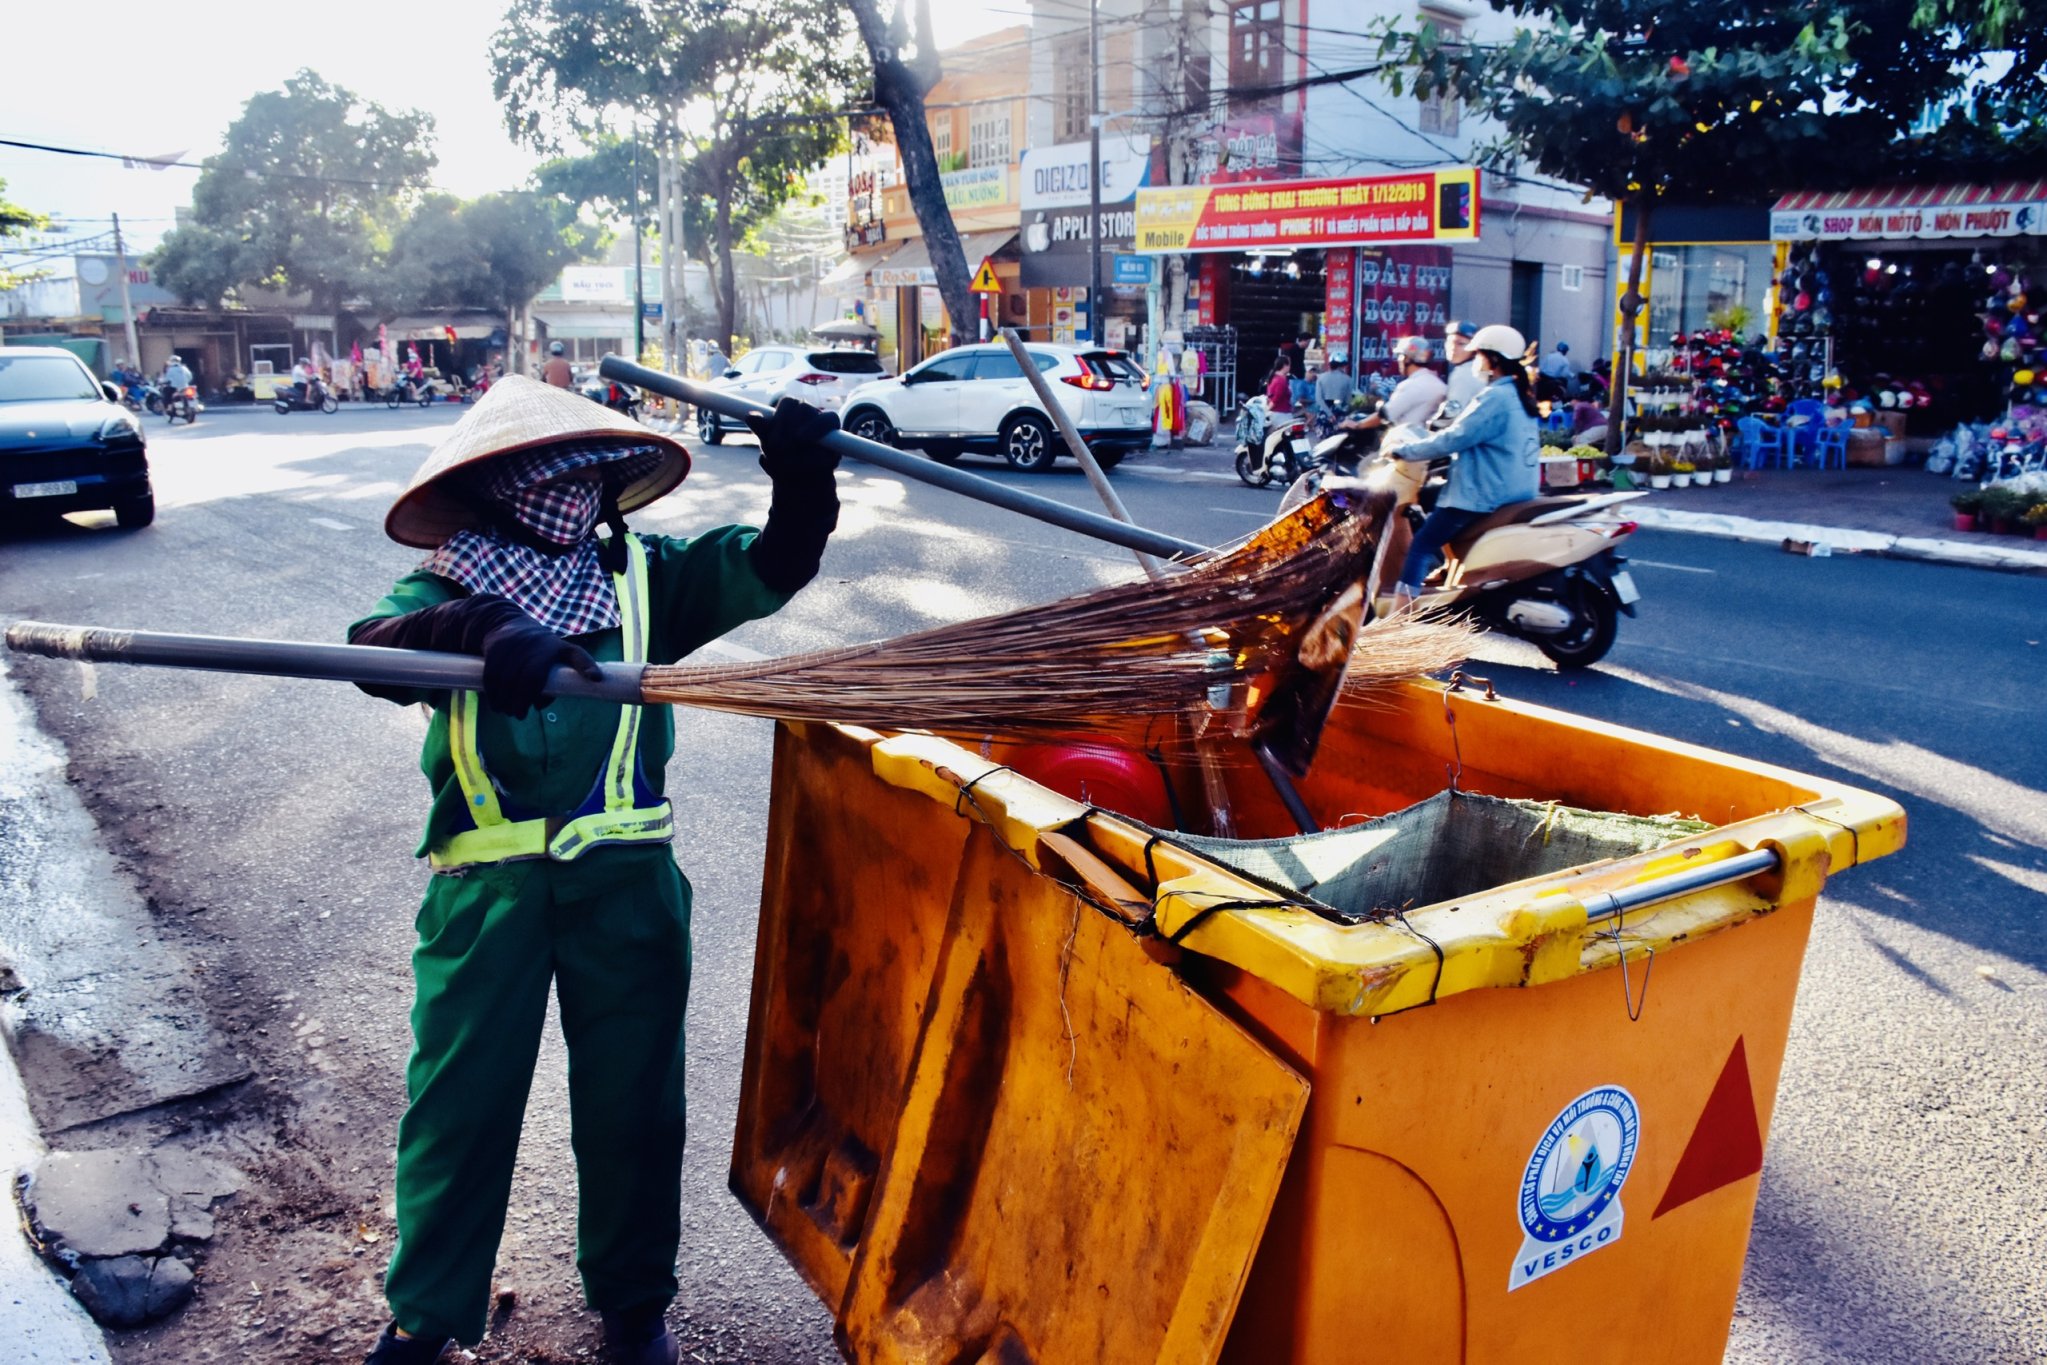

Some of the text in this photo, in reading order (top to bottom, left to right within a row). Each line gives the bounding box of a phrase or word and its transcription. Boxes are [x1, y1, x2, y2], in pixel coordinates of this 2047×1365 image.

[1034, 160, 1111, 195] DIGIZOE
[1271, 190, 1296, 209] KHAI
[1341, 182, 1370, 205] NGÀY
[1373, 182, 1426, 204] 1/12/2019
[1145, 230, 1185, 247] Mobile
[1314, 217, 1324, 235] 11
[1823, 216, 1854, 234] SHOP
[1365, 295, 1446, 326] BÓP DA
[1524, 1226, 1611, 1277] VESCO
